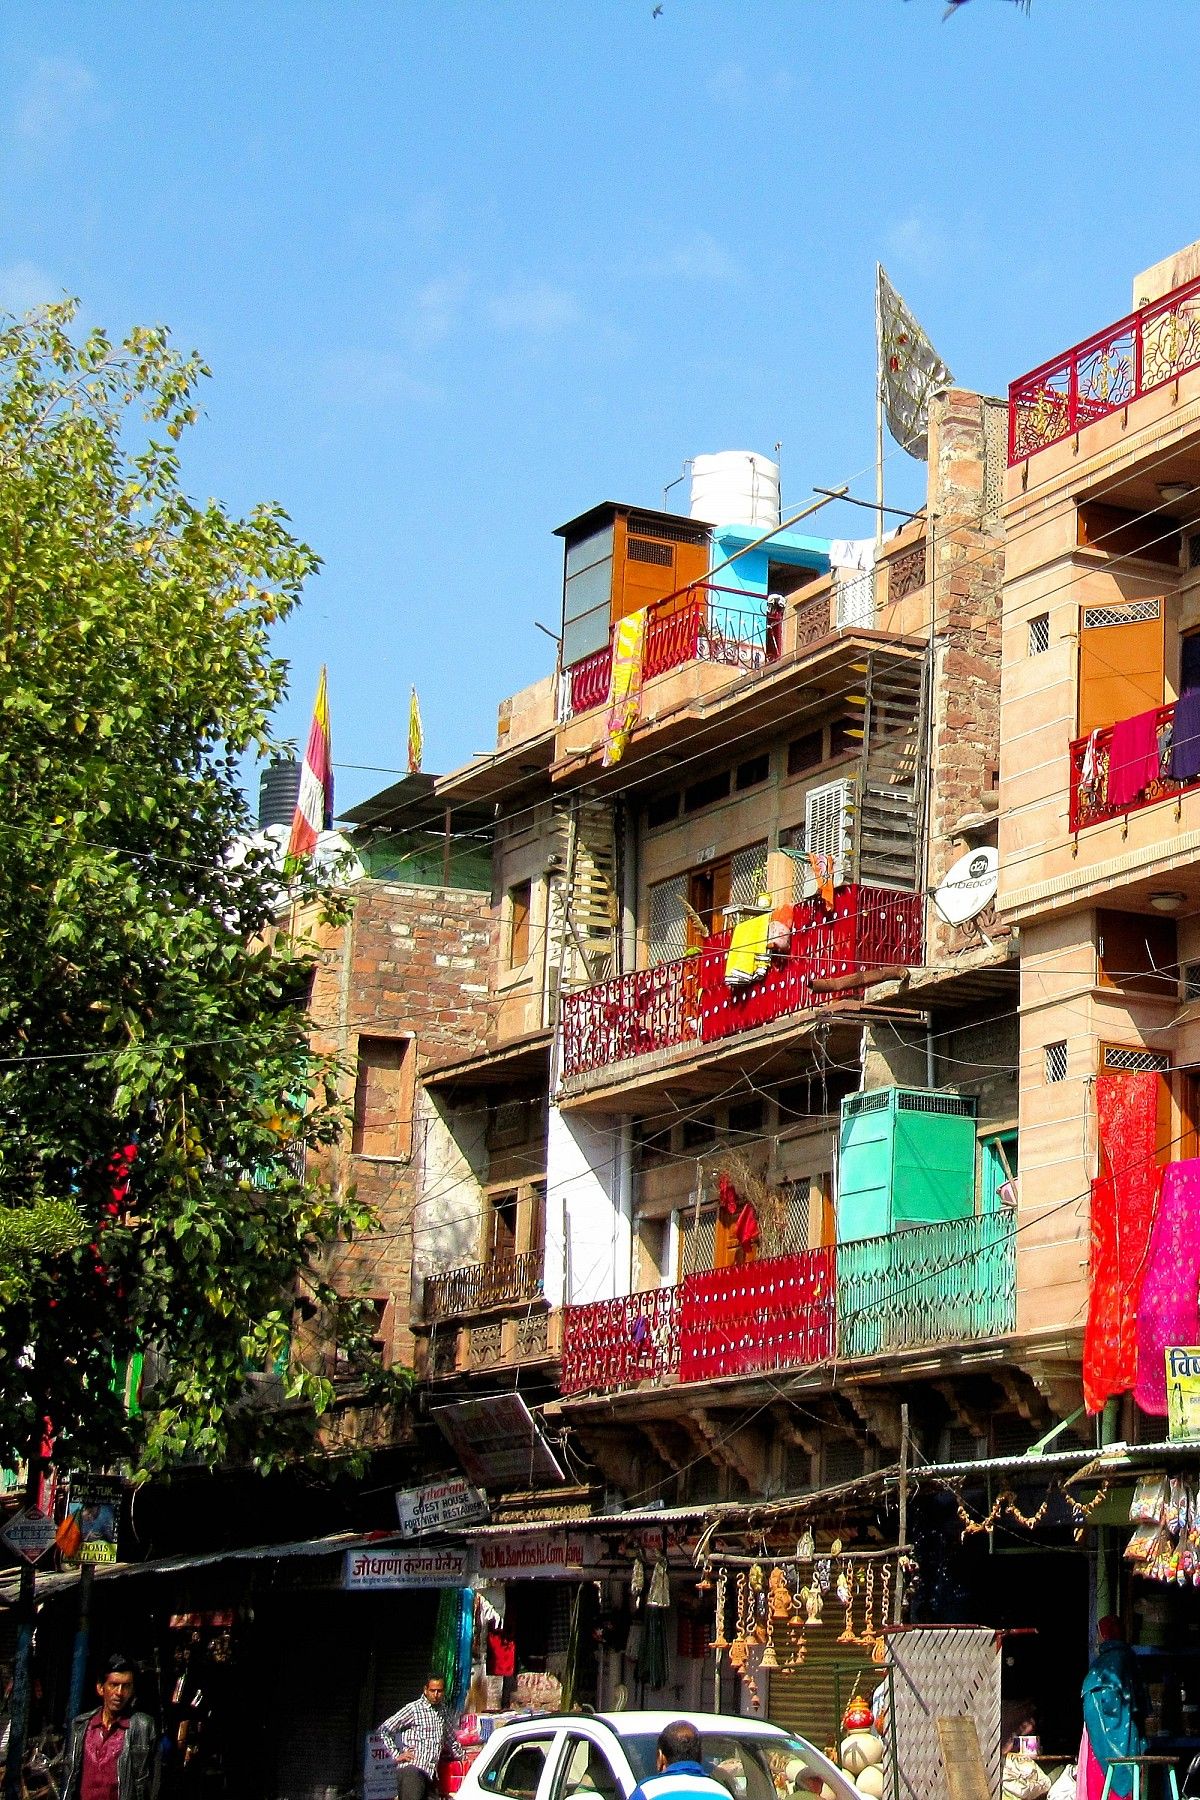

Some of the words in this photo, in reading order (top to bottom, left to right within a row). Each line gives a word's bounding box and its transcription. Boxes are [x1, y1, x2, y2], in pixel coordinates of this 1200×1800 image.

[412, 1501, 440, 1516] GUEST
[441, 1493, 469, 1508] HOUSE
[404, 1517, 420, 1530] FORT
[423, 1512, 440, 1525] VIEW
